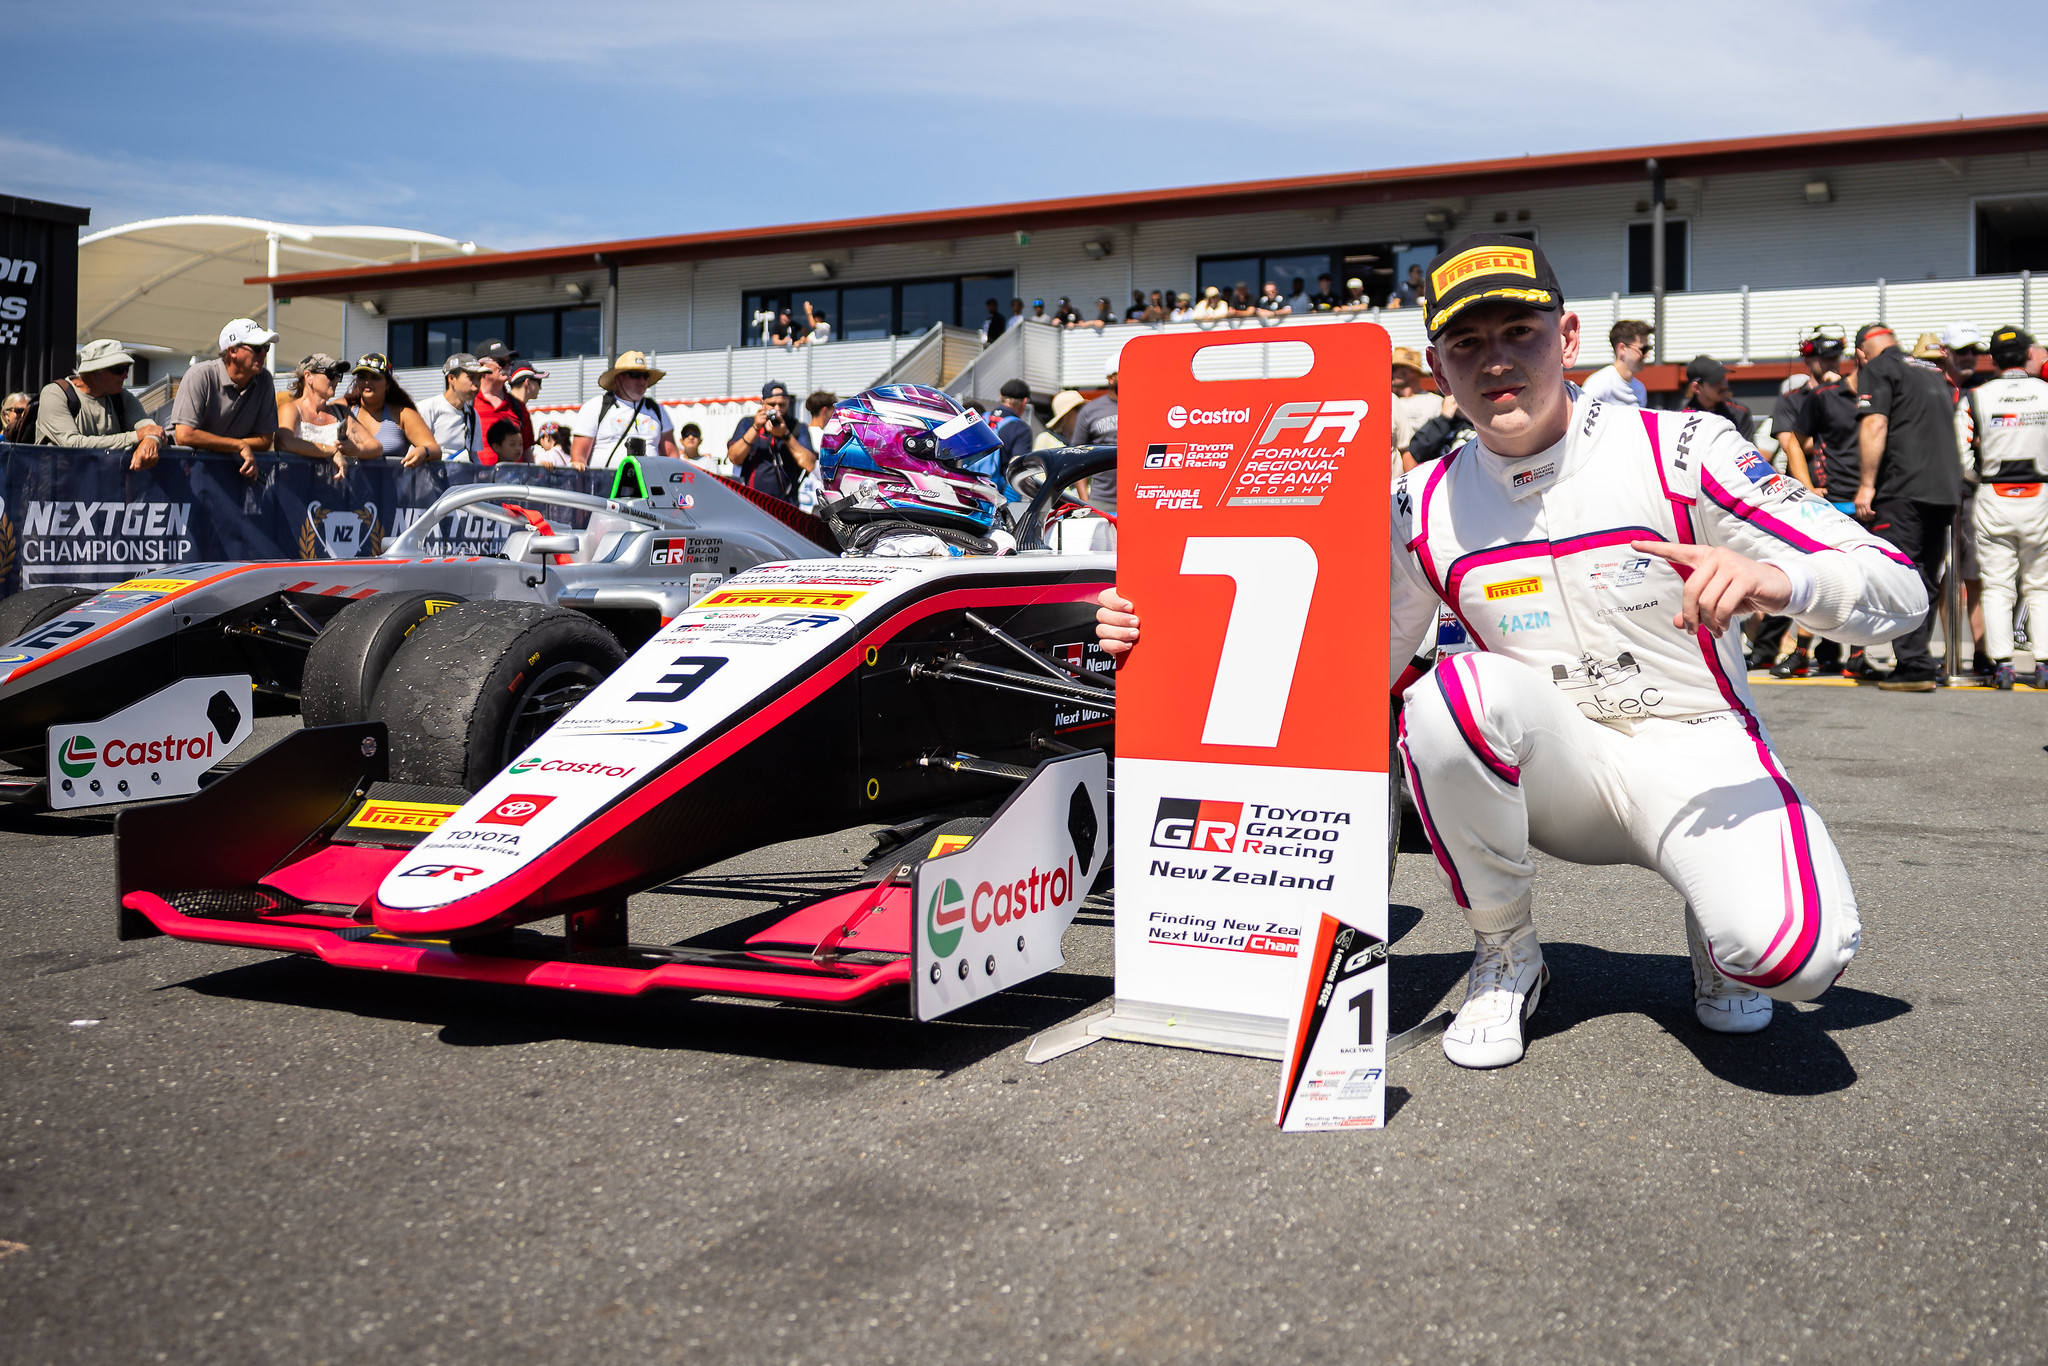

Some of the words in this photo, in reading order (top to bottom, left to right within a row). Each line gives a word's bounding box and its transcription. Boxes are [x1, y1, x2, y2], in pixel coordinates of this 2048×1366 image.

[1437, 251, 1527, 291] PIRELLI
[1189, 407, 1250, 425] Castrol
[1259, 399, 1369, 445] FR
[1188, 444, 1234, 452] TOYOTA
[1674, 415, 1703, 471] HRX
[1146, 452, 1183, 468] GR
[1186, 452, 1229, 460] GAZOO
[1251, 447, 1345, 459] FORMULA
[1185, 459, 1227, 470] Racing
[1244, 460, 1339, 472] REGIONAL
[669, 471, 695, 484] GR
[1239, 472, 1332, 485] OCEANIA
[1514, 474, 1532, 486] GR
[883, 483, 907, 493] Zack
[906, 487, 940, 499] Scoular
[1136, 489, 1200, 499] SUSTAINABLE
[1235, 486, 1329, 494] TROPHY
[1155, 498, 1203, 509] FUEL
[23, 500, 191, 536] NEXTGEN
[333, 525, 354, 542] NZ
[688, 538, 723, 546] TOYOTA
[23, 540, 191, 562] CHAMPIONSHIP
[651, 548, 684, 564] GR
[686, 555, 718, 564] Racing
[687, 547, 719, 555] GAZOO
[1487, 579, 1539, 599] PIRELLI
[705, 592, 853, 606] PIRELLI
[1597, 600, 1658, 617] PUREWEAR
[756, 613, 839, 628] FR
[1511, 611, 1551, 632] AZM
[8, 621, 96, 649] 12
[1179, 536, 1319, 748] 1
[1086, 659, 1111, 672] New
[626, 656, 730, 702] 3
[1055, 710, 1080, 726] Next
[103, 731, 213, 768] Castrol
[540, 760, 636, 778] Castrol
[359, 806, 457, 828] PIRELL
[1250, 804, 1351, 825] TOYOTA
[447, 831, 520, 845] TOYOTA
[1153, 817, 1236, 852] GR
[1246, 822, 1340, 842] GAZOO
[473, 844, 520, 856] Services
[1242, 839, 1334, 864] Racing
[398, 864, 484, 882] GR
[1149, 860, 1208, 880] New
[1211, 865, 1335, 891] Zealand
[971, 855, 1074, 933] Castrol
[1149, 911, 1217, 931] Finding
[1223, 918, 1260, 932] New
[1149, 927, 1188, 941] Next
[1193, 931, 1245, 946] World
[1349, 988, 1374, 1045] 1
